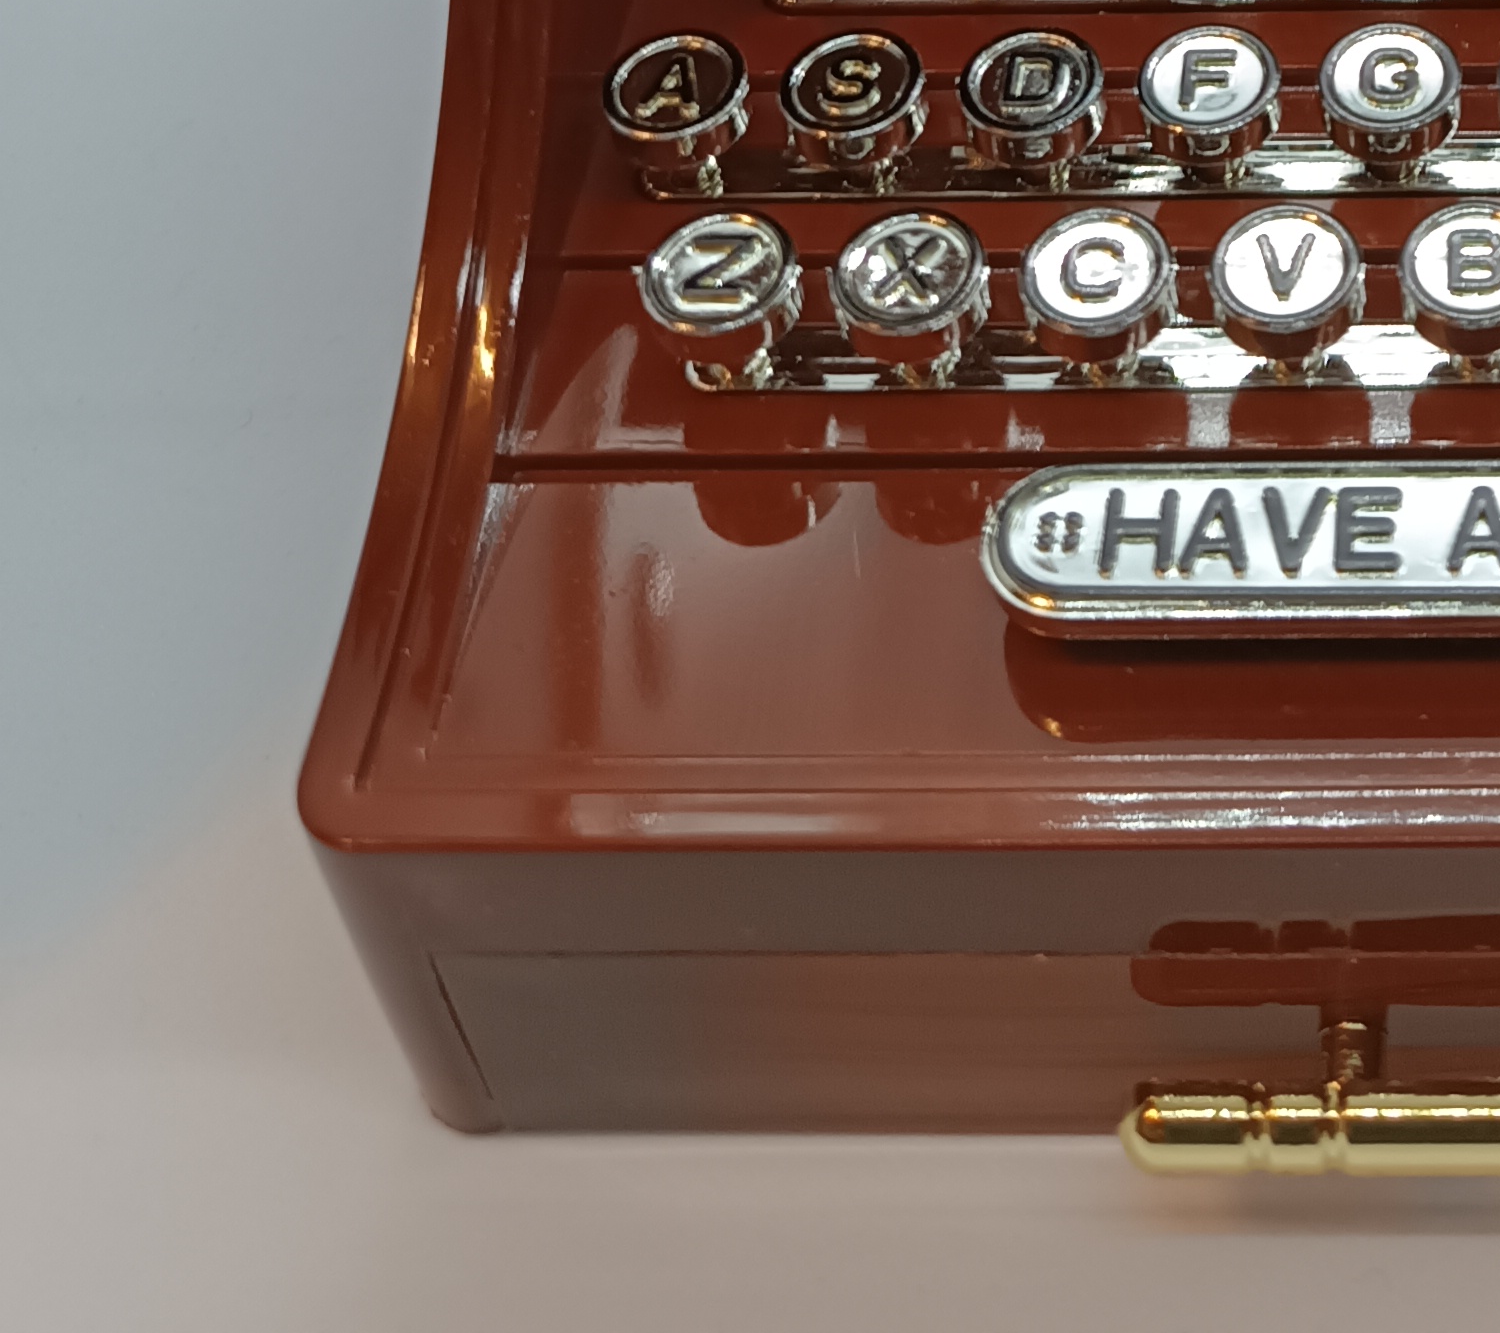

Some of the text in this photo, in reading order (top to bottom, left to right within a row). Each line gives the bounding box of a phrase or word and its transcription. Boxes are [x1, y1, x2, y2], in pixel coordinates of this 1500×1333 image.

[636, 51, 702, 118] A
[815, 56, 884, 116] S
[1007, 52, 1075, 110] D
[1176, 47, 1240, 113] F
[1356, 45, 1421, 110] G
[677, 237, 766, 305] Z
[873, 232, 948, 306] X
[1059, 234, 1126, 304] C
[1254, 232, 1315, 303] V
[1099, 485, 1402, 580] HAVE
